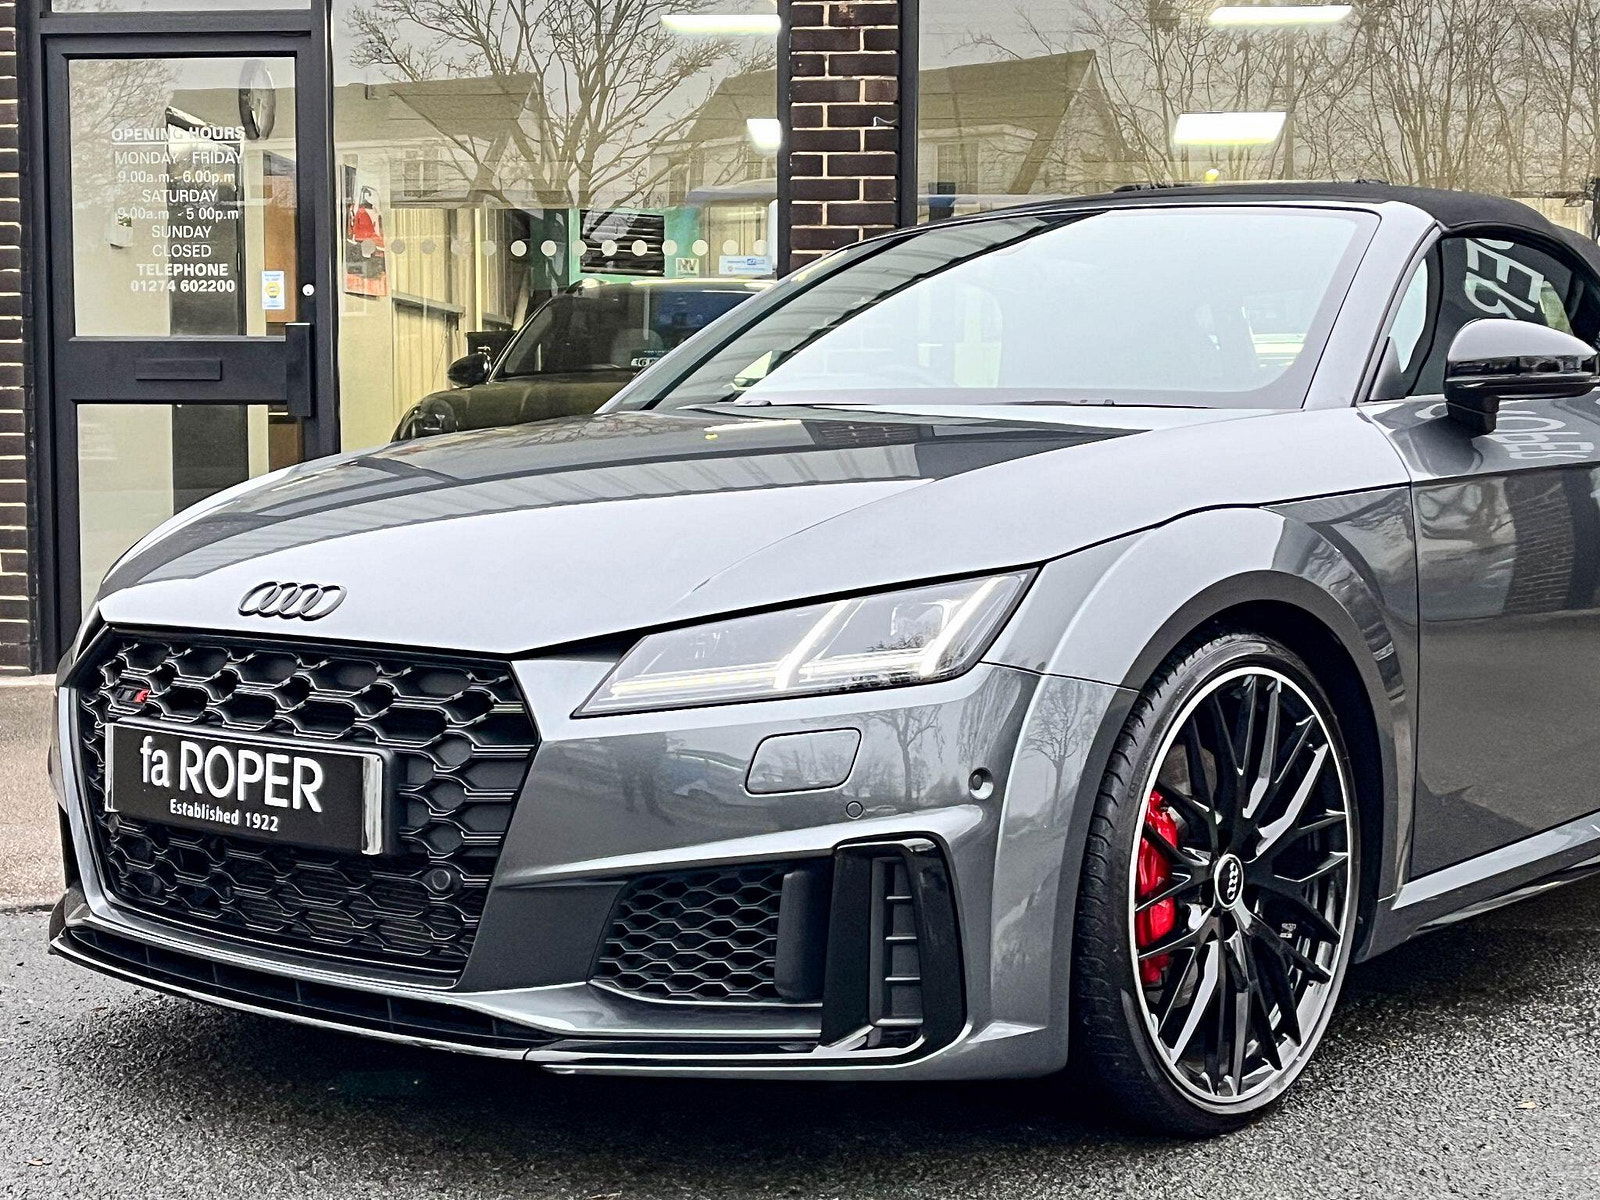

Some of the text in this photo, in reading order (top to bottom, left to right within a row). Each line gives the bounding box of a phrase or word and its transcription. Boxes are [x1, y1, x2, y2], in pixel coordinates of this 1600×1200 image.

[111, 126, 245, 141] OPENING HOURS
[114, 151, 179, 164] MONDAY
[192, 151, 241, 164] FRIDAY
[142, 189, 218, 202] SATURDAY
[151, 225, 212, 238] SUNDAY
[152, 244, 212, 257] CLOSED
[136, 263, 229, 277] TELEPHONE
[130, 280, 236, 292] 01274 602200
[140, 735, 323, 813] fa ROPER
[169, 798, 279, 832] Established 1922
